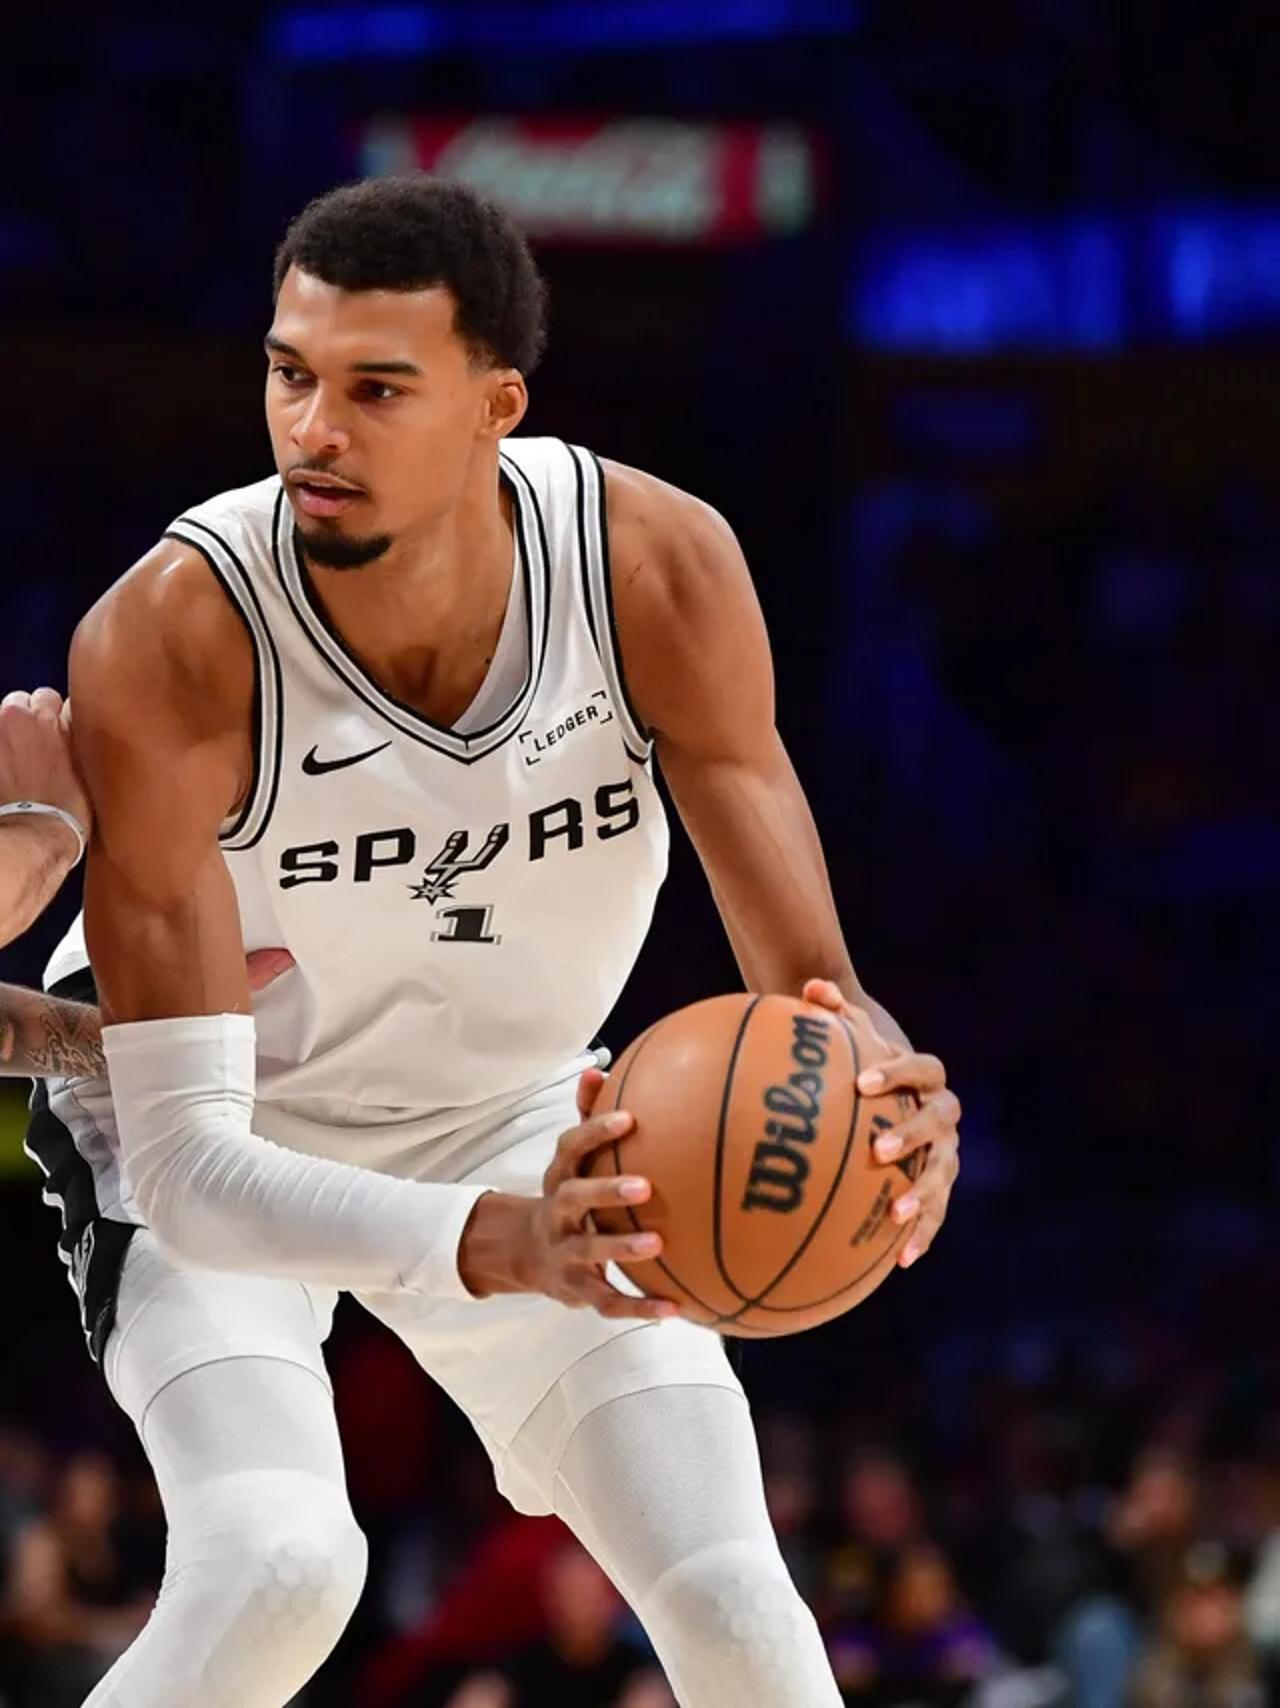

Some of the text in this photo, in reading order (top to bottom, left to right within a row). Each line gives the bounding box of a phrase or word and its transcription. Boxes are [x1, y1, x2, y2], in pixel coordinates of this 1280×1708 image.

[534, 705, 599, 752] LEDGER
[280, 779, 640, 905] SPURS
[431, 904, 502, 945] 1
[742, 1014, 830, 1213] Wilson
